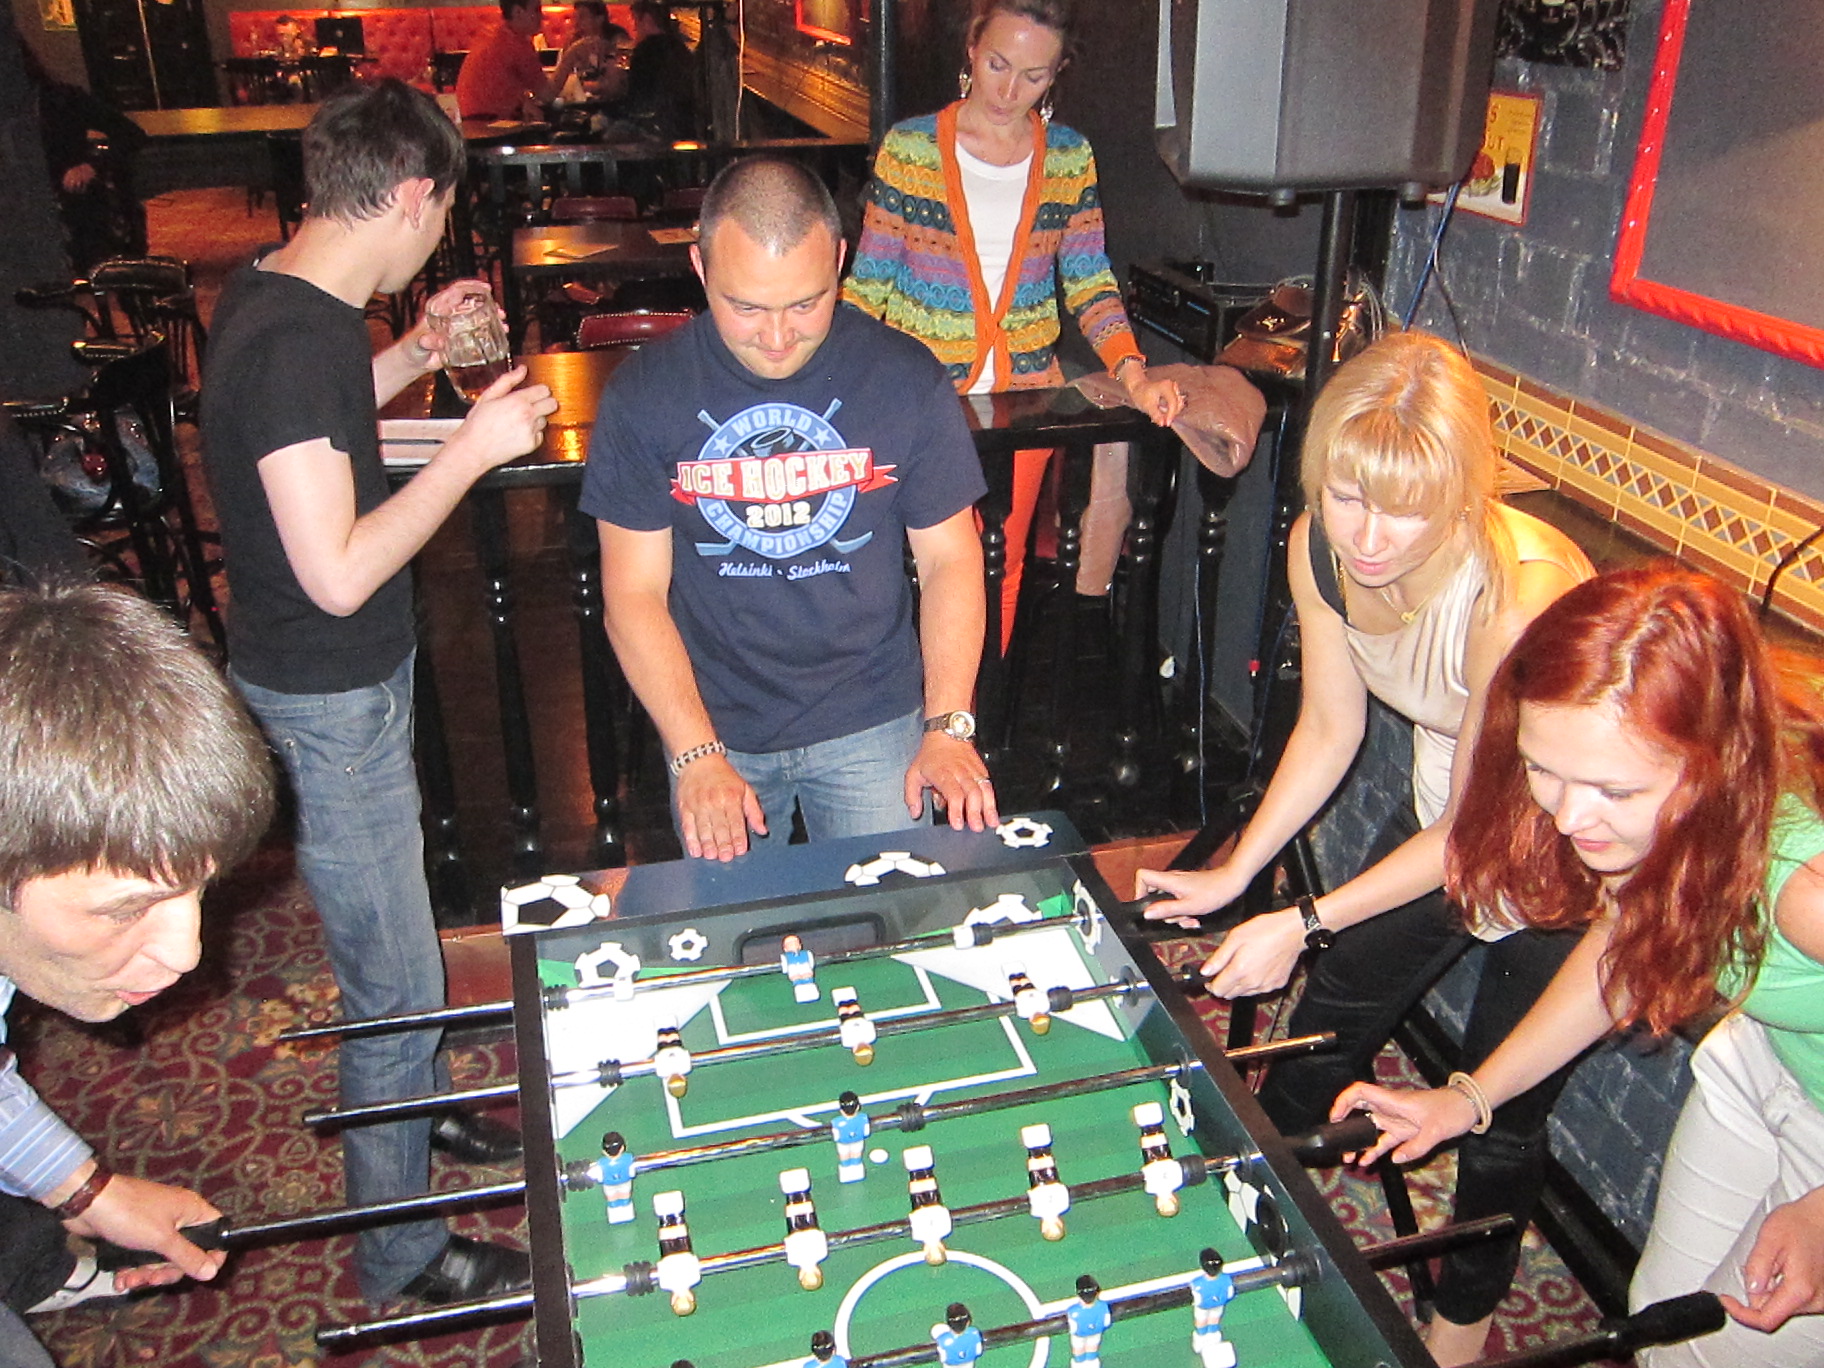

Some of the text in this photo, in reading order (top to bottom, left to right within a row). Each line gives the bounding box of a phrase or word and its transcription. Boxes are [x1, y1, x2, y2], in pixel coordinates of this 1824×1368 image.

[731, 408, 813, 438] WORLD
[681, 452, 869, 501] ICE HOCKEY
[706, 491, 849, 554] CHAMPIONSHIP
[745, 501, 811, 529] 2012
[718, 558, 851, 581] Helsinki Stockholm
